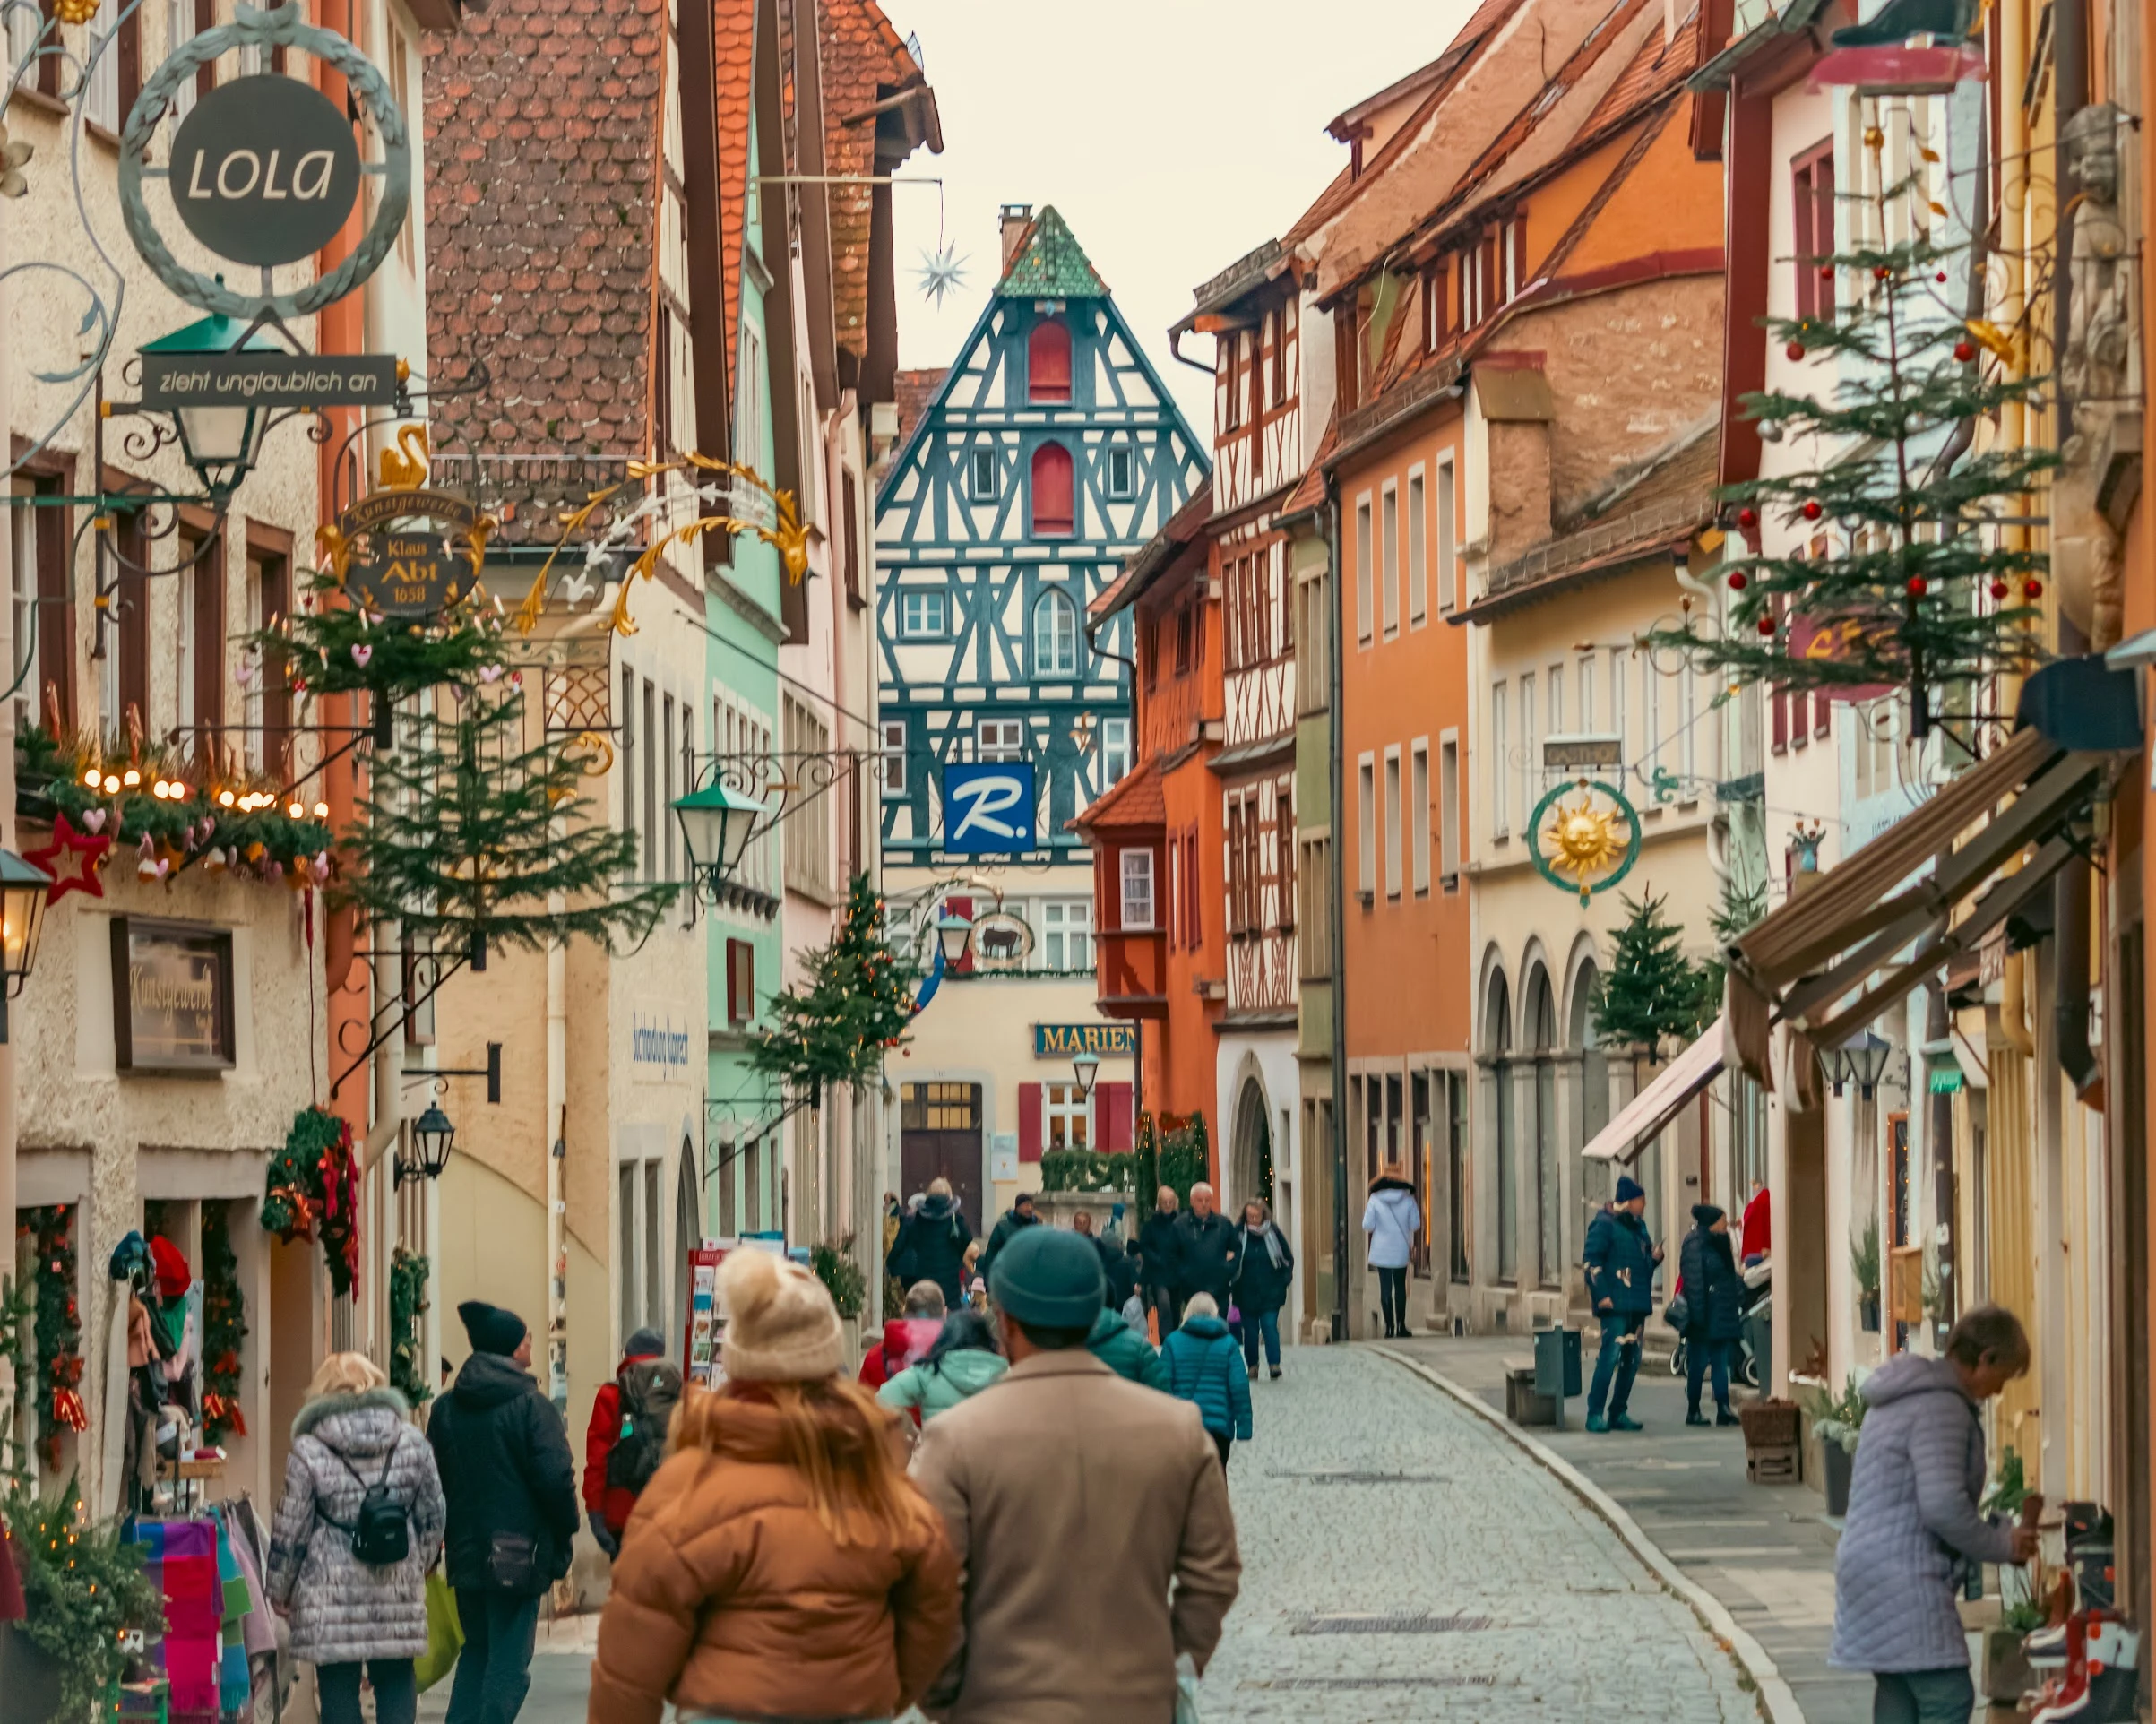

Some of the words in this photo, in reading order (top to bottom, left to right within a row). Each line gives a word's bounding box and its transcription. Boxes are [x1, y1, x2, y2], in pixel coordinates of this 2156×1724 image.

[160, 370, 211, 392] zieht
[216, 370, 341, 397] unglaublich
[348, 374, 377, 392] an
[387, 539, 428, 557] Klaus
[381, 560, 438, 584] Abt
[394, 585, 426, 603] 1658
